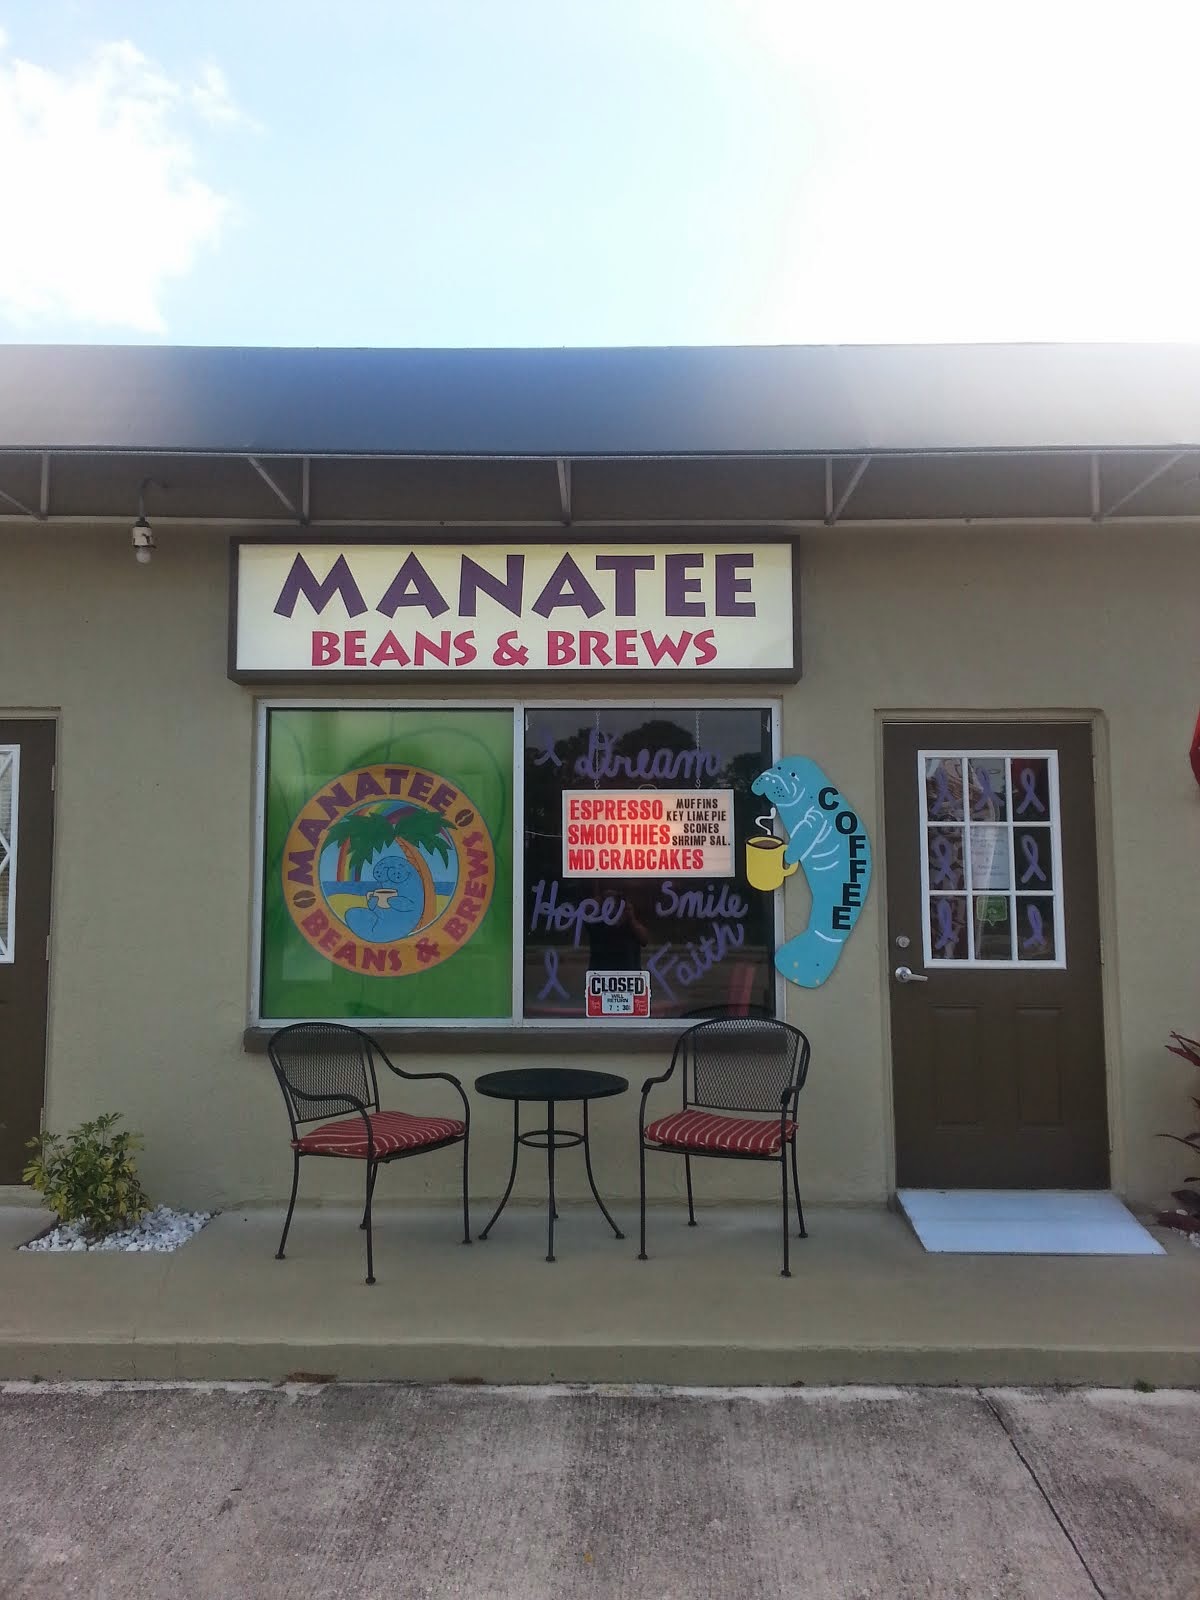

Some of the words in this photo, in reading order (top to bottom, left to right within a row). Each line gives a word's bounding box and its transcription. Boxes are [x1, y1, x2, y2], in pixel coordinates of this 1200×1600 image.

[273, 551, 756, 619] MANATEE
[311, 630, 477, 667] BEANS
[492, 630, 529, 667] &
[547, 629, 718, 667] BREWS
[570, 799, 663, 821] ESPRESSO
[666, 810, 684, 822] KEY
[687, 810, 709, 822] LIME
[711, 810, 727, 822] PIE
[676, 798, 718, 809] MUFFINS
[287, 768, 458, 887] MANATEE
[568, 824, 671, 845] SMOOTHIES
[672, 835, 706, 846] SHRIMP
[709, 835, 731, 846] SAL.
[683, 823, 719, 834] SCONES
[818, 787, 867, 930] COFFEE
[301, 908, 403, 972] BEANS
[415, 937, 441, 964] &
[442, 831, 489, 942] BREWS
[531, 879, 626, 949] Hope
[656, 881, 749, 919] Smile
[647, 922, 745, 1005] Faith
[591, 977, 645, 995] CLOSED
